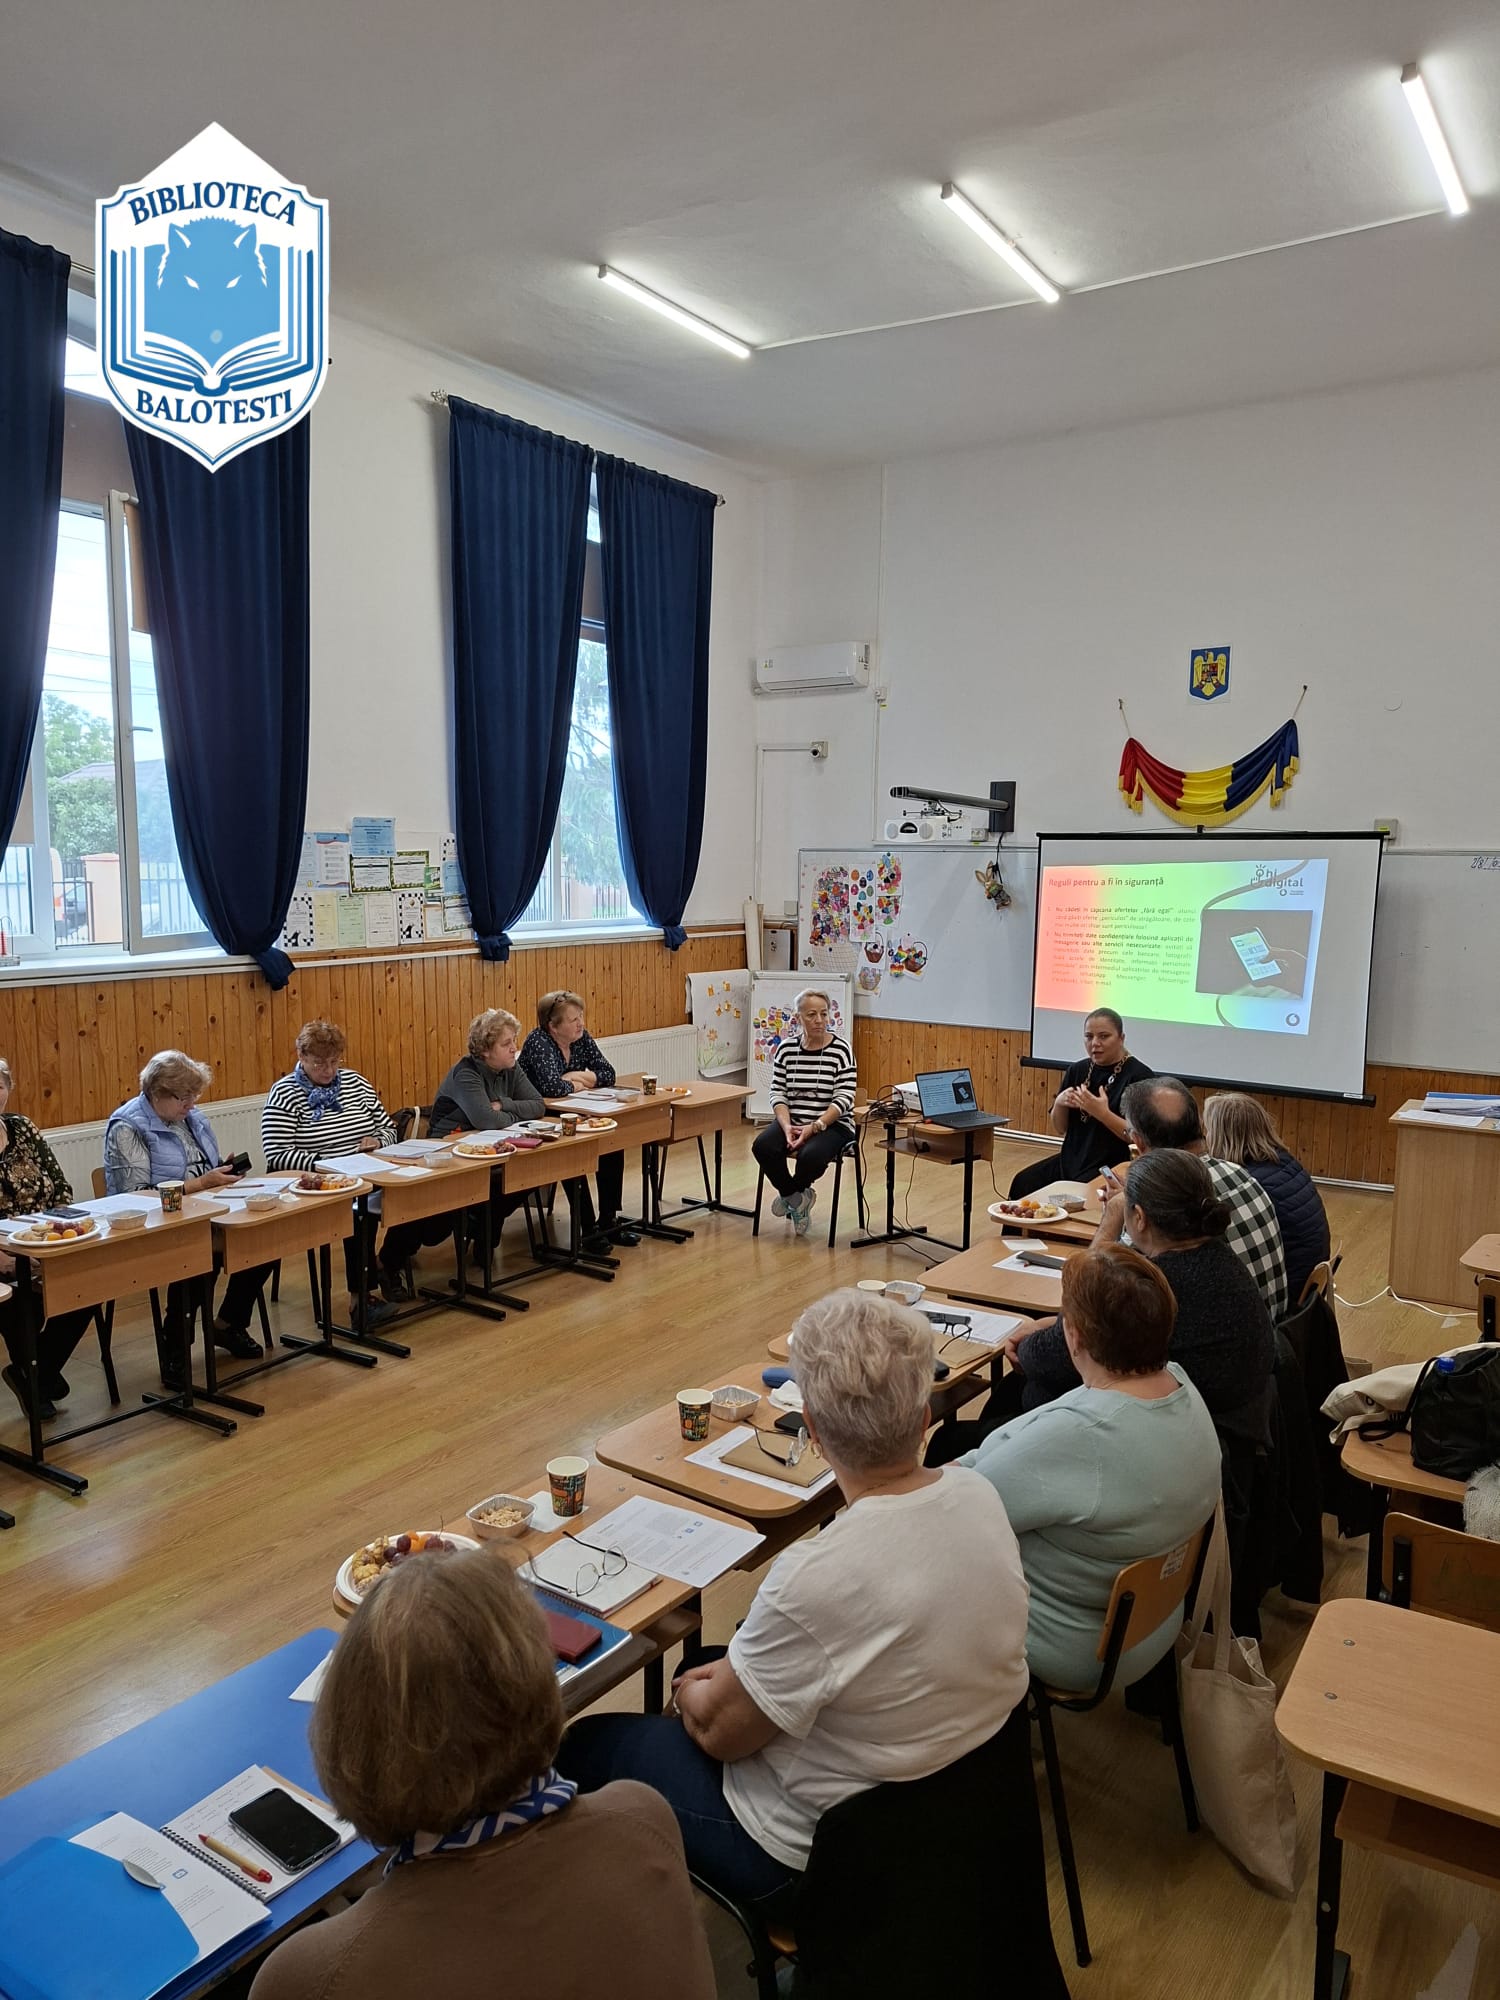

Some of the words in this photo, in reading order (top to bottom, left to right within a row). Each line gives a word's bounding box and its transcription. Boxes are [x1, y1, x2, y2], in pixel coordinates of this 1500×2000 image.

[1073, 879, 1099, 887] pentru
[1107, 877, 1113, 886] fi
[1115, 877, 1124, 886] în
[1124, 876, 1165, 888] siguranță
[1265, 877, 1304, 889] digital
